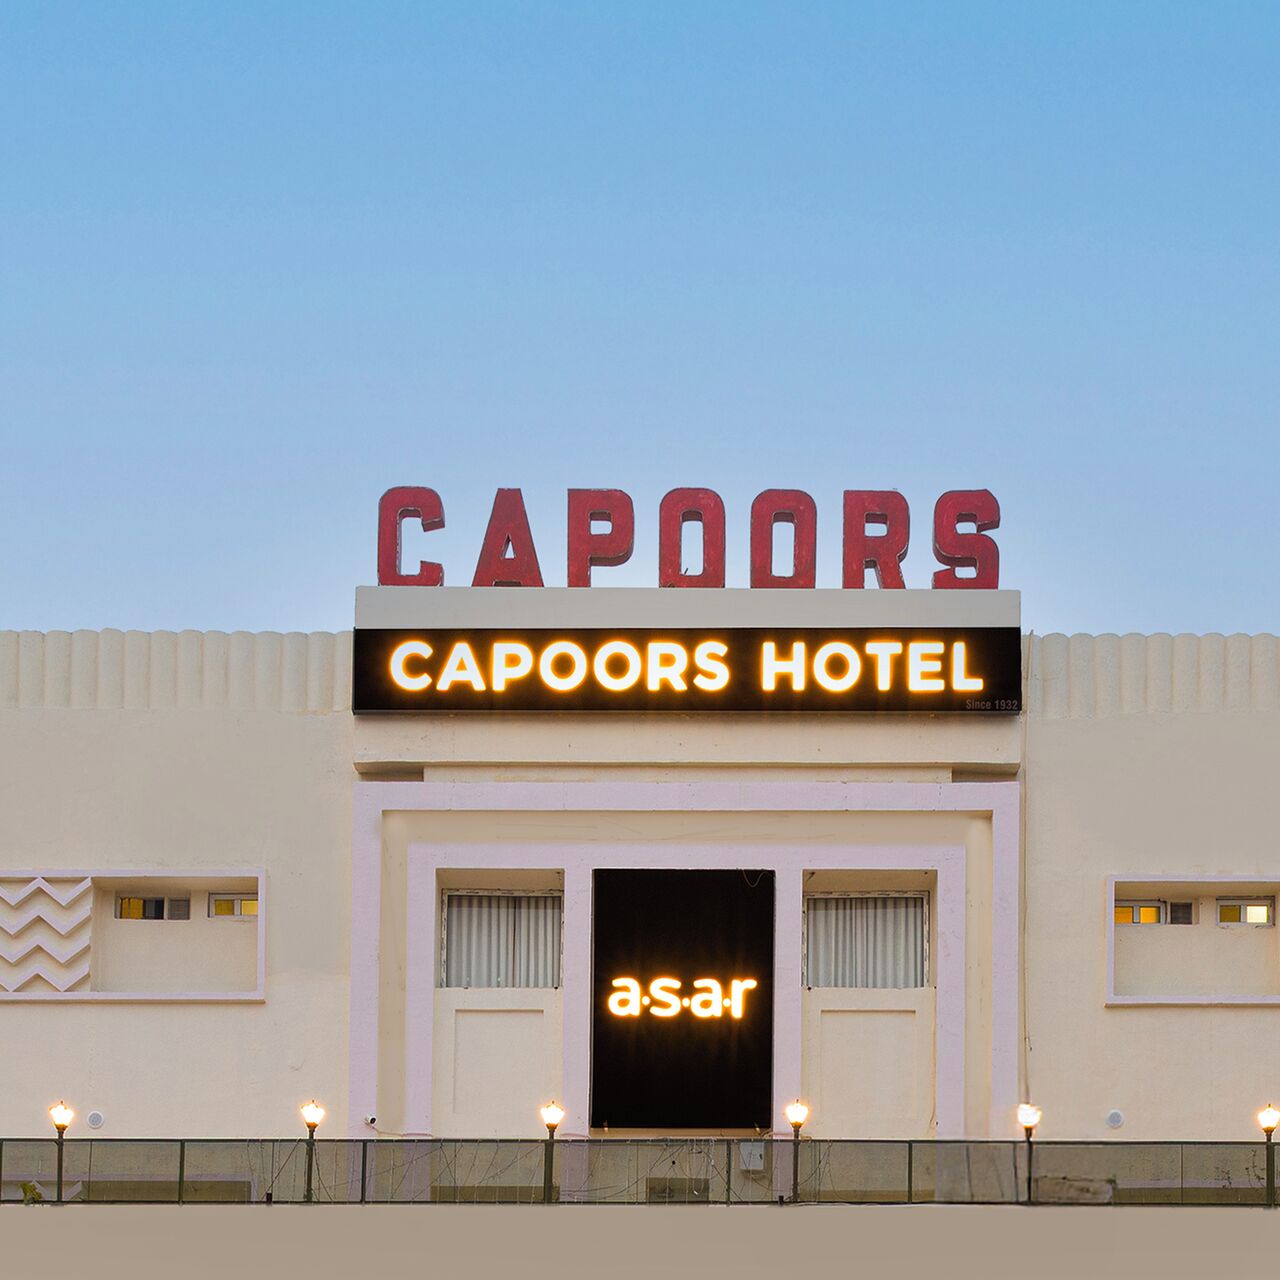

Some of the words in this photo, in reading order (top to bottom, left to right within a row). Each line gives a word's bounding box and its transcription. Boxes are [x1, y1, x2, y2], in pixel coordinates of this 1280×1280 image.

[377, 486, 1001, 588] CAPOORS
[388, 639, 731, 694] CAPOORS
[760, 640, 986, 694] HOTEL
[965, 699, 992, 710] Since
[994, 699, 1019, 710] 1932
